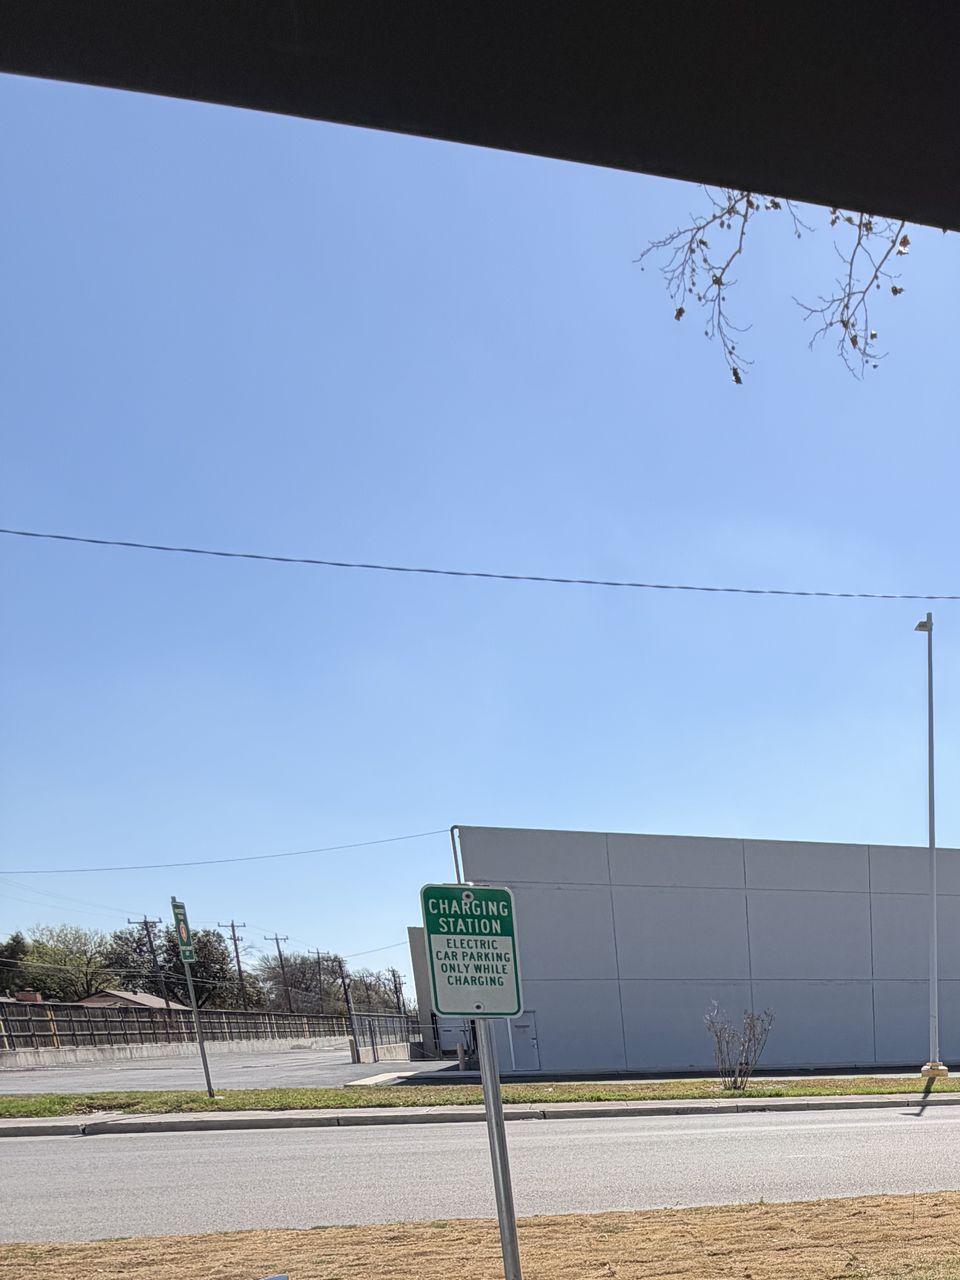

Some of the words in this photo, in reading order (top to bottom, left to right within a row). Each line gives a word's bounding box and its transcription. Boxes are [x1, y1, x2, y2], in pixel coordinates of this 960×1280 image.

[428, 899, 509, 916] CHARGING
[439, 917, 502, 934] STATION
[446, 938, 498, 950] ELECTRIC
[436, 950, 458, 961] CAR
[461, 951, 511, 963] PARKING
[440, 963, 470, 974] ONLY
[473, 963, 508, 975] WHILE
[447, 975, 505, 987] CHARGING
